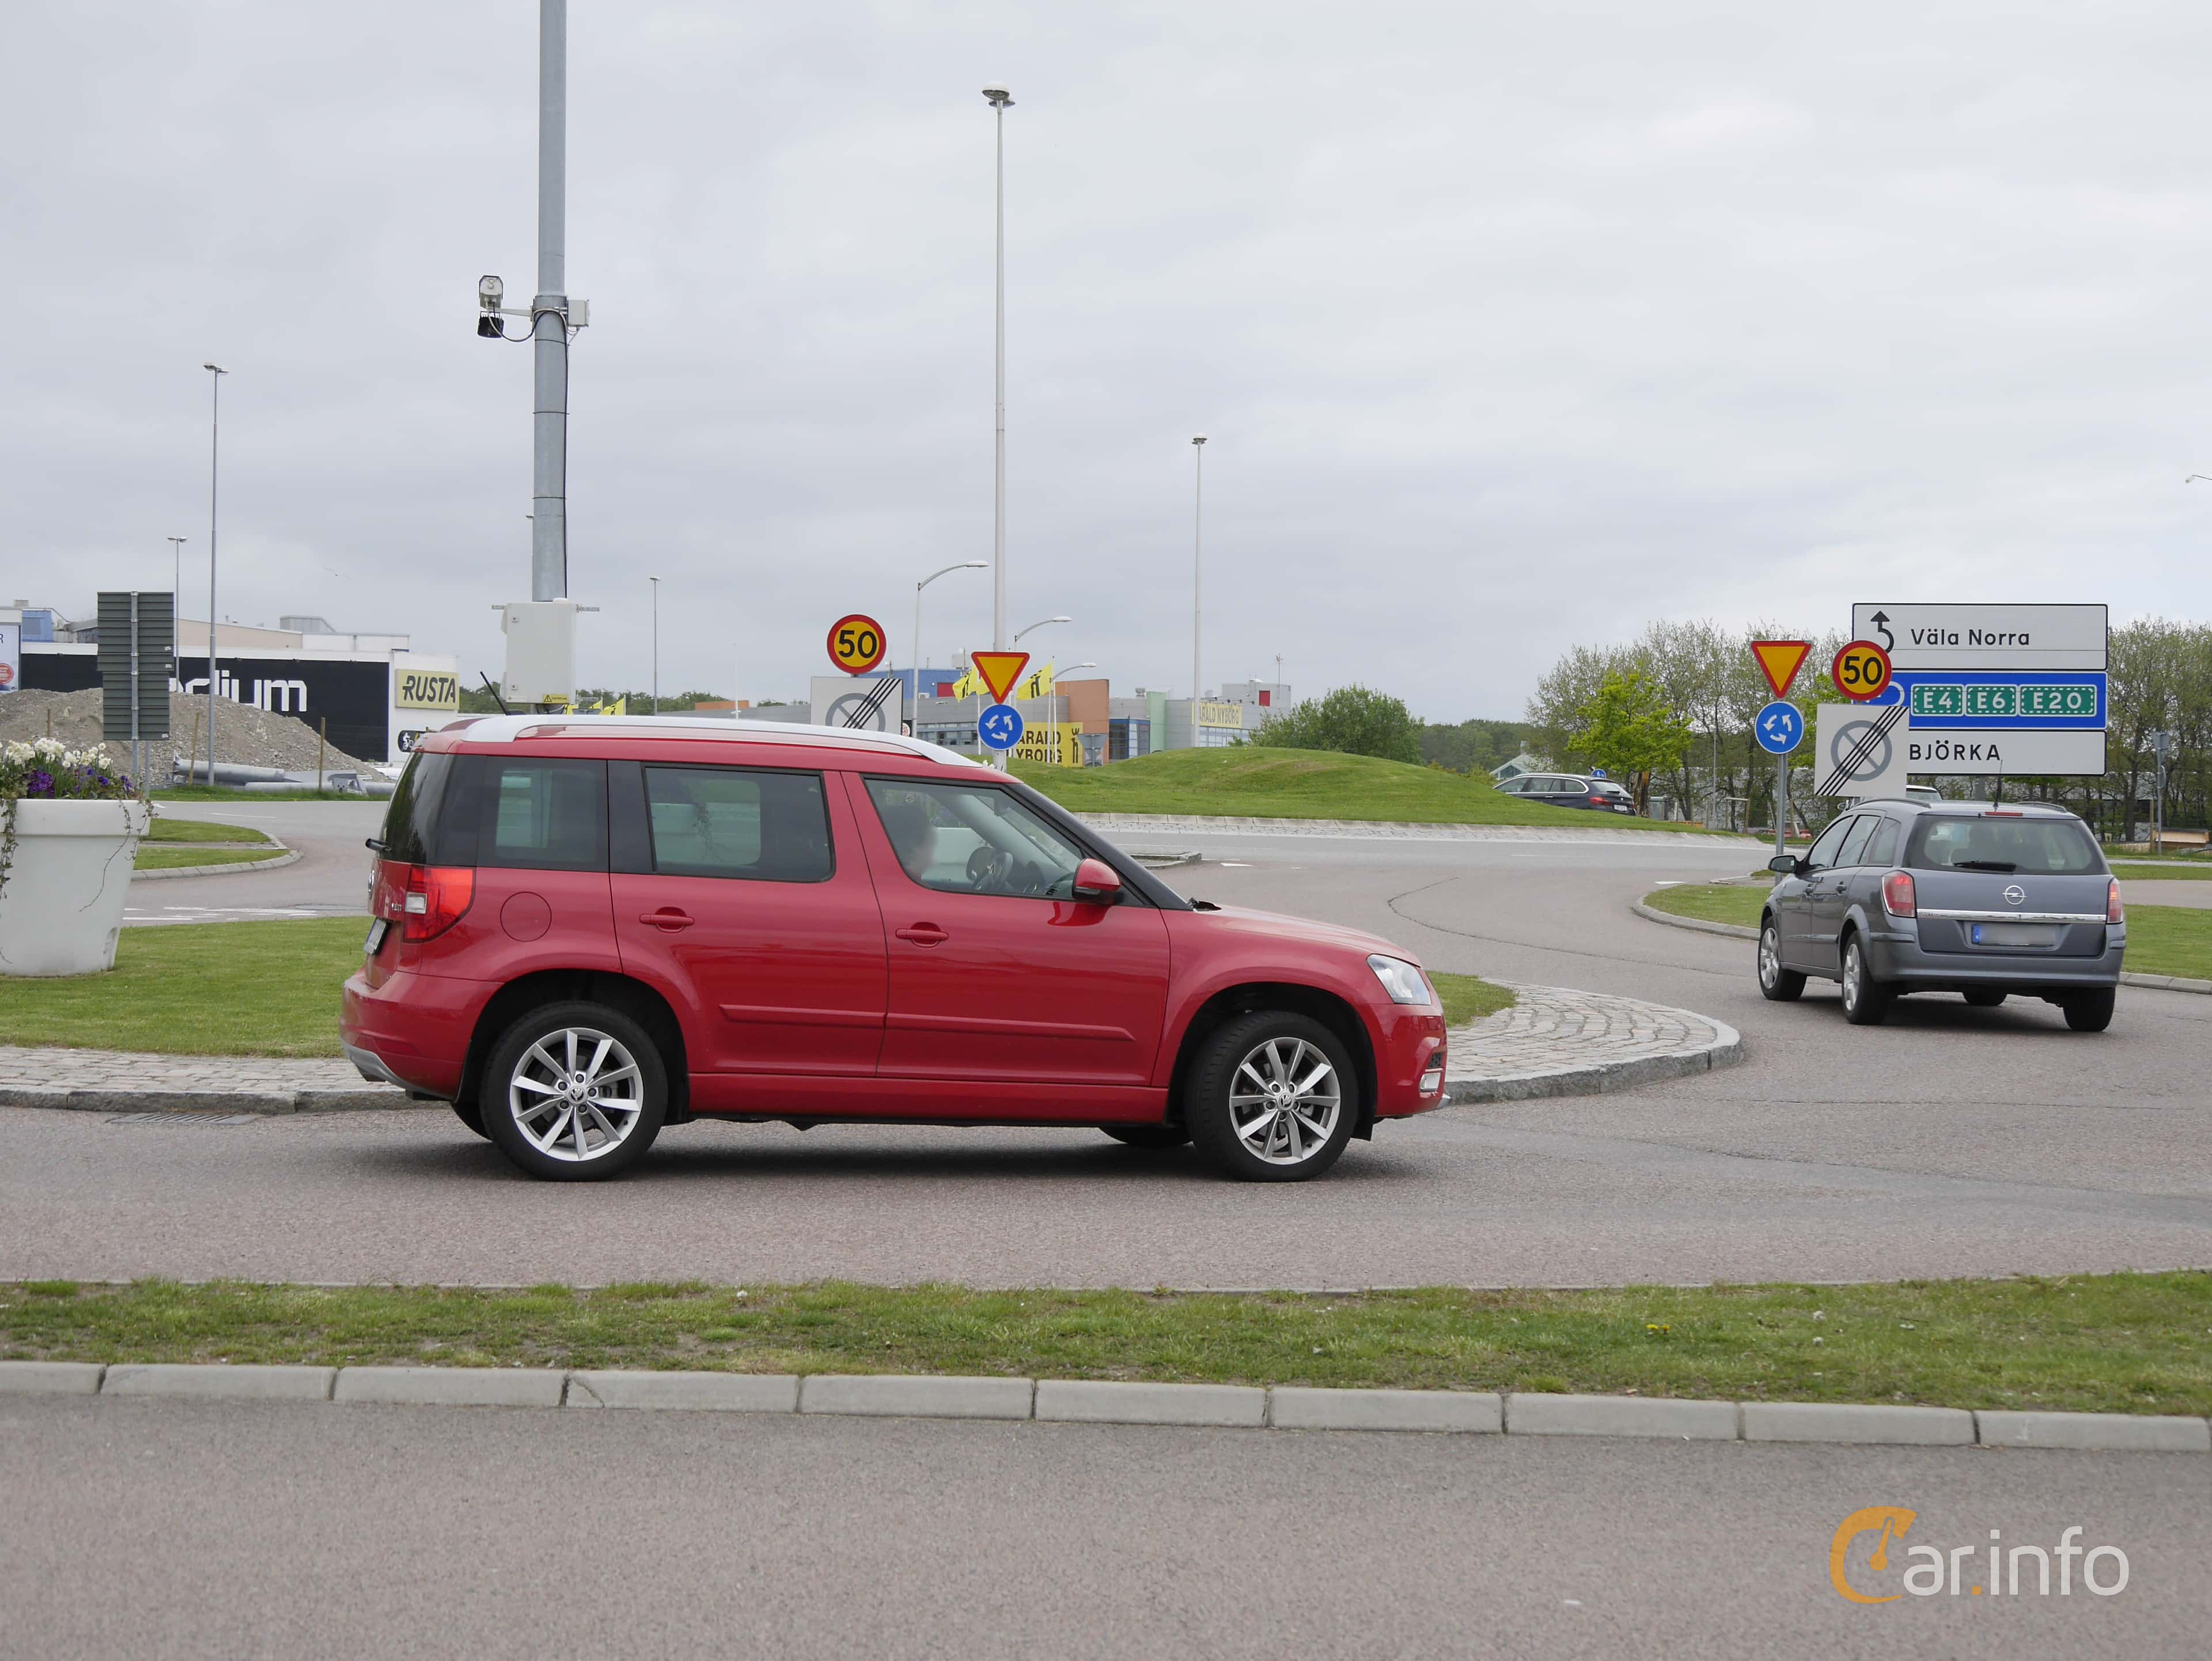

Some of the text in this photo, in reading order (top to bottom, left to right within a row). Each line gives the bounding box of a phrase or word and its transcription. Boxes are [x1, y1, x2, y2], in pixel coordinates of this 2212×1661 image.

[839, 630, 877, 659] 50
[1911, 629, 2029, 645] Väla Norra
[1843, 656, 1883, 685] 50
[402, 675, 456, 703] RUSTA
[1923, 692, 2082, 709] E4 E6 E20
[1018, 731, 1061, 745] ARALD
[1910, 740, 2000, 760] BJÖRKA
